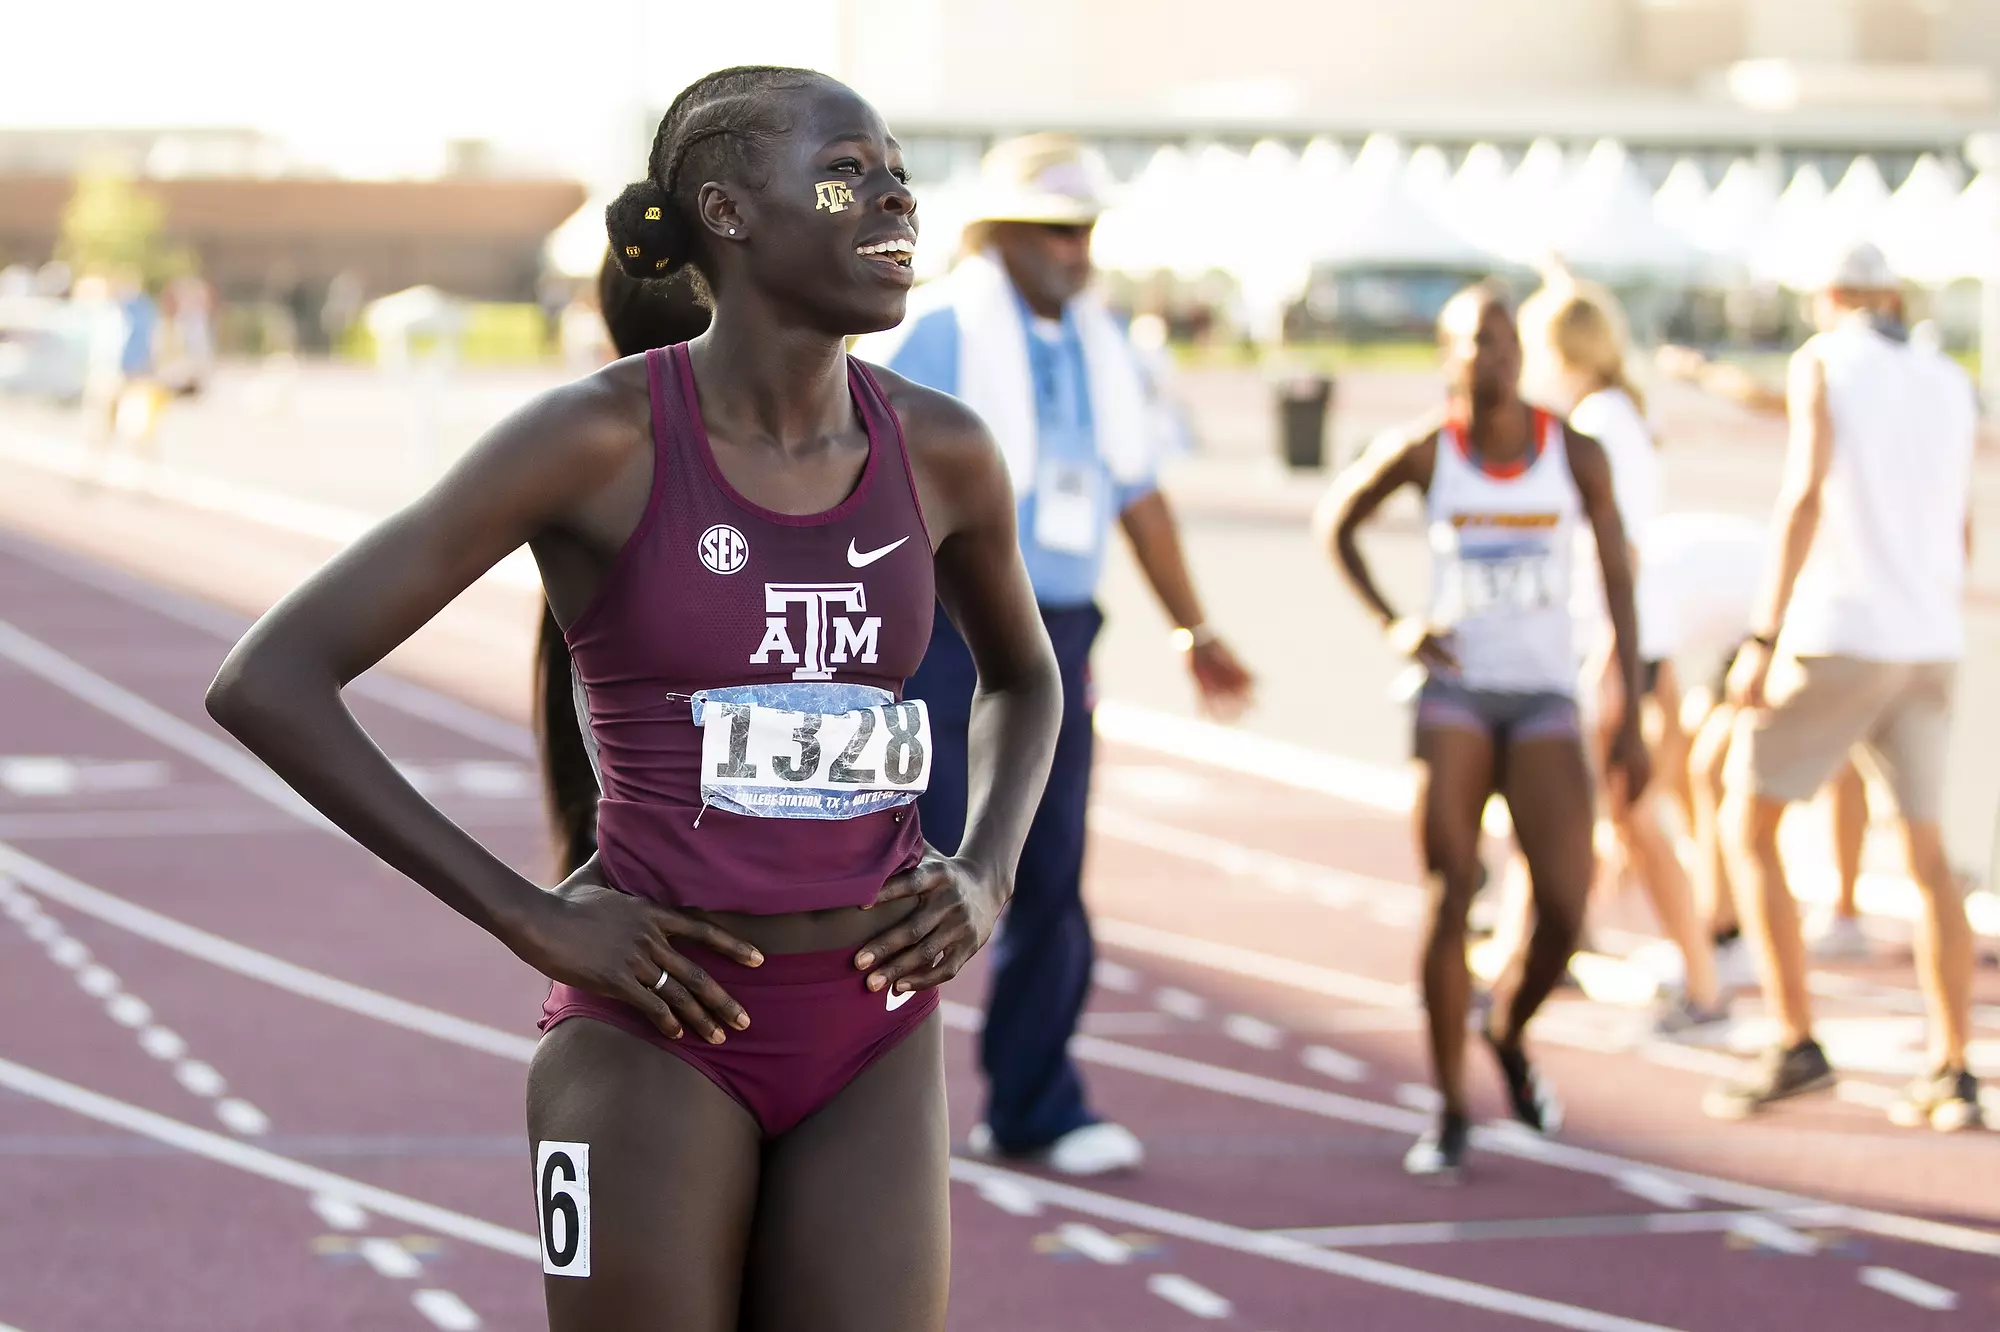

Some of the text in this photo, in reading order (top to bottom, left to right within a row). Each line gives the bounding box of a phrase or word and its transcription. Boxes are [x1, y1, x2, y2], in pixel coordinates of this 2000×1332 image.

[703, 528, 744, 572] SEC
[716, 701, 924, 784] 1328
[779, 794, 823, 809] STATION,
[826, 796, 840, 809] TX
[852, 792, 873, 806] MAY
[542, 1151, 579, 1267] 6
